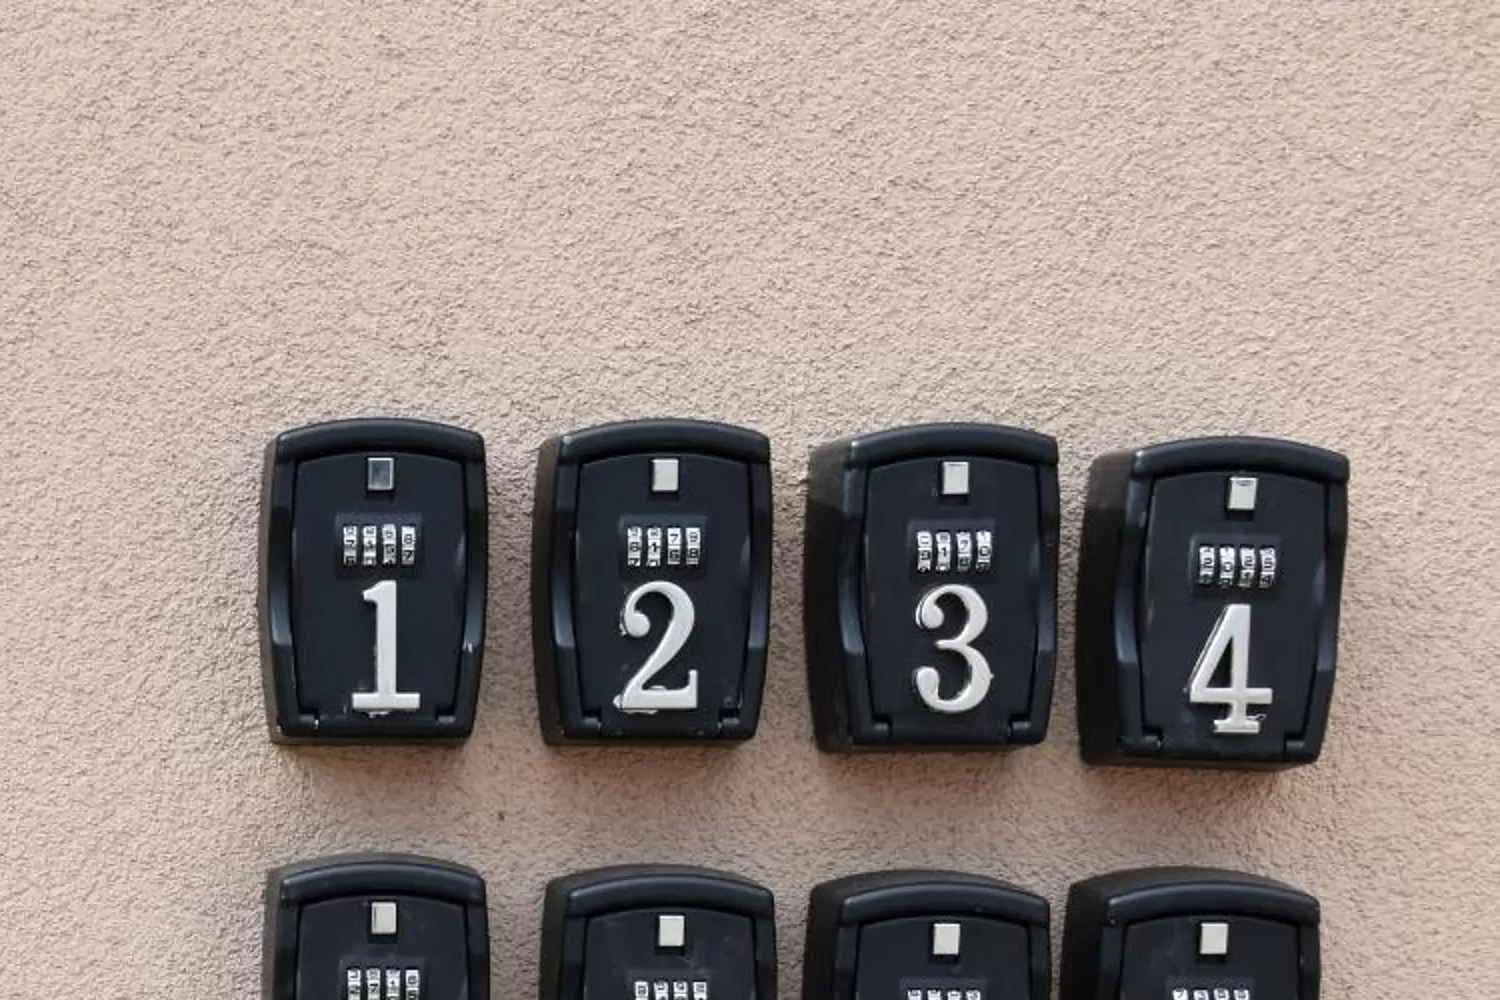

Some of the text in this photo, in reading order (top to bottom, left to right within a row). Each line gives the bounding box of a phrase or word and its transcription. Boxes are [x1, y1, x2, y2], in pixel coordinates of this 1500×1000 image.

[352, 580, 420, 709] 1
[613, 581, 698, 713] 2
[915, 584, 993, 712] 3
[1190, 603, 1272, 734] 4
